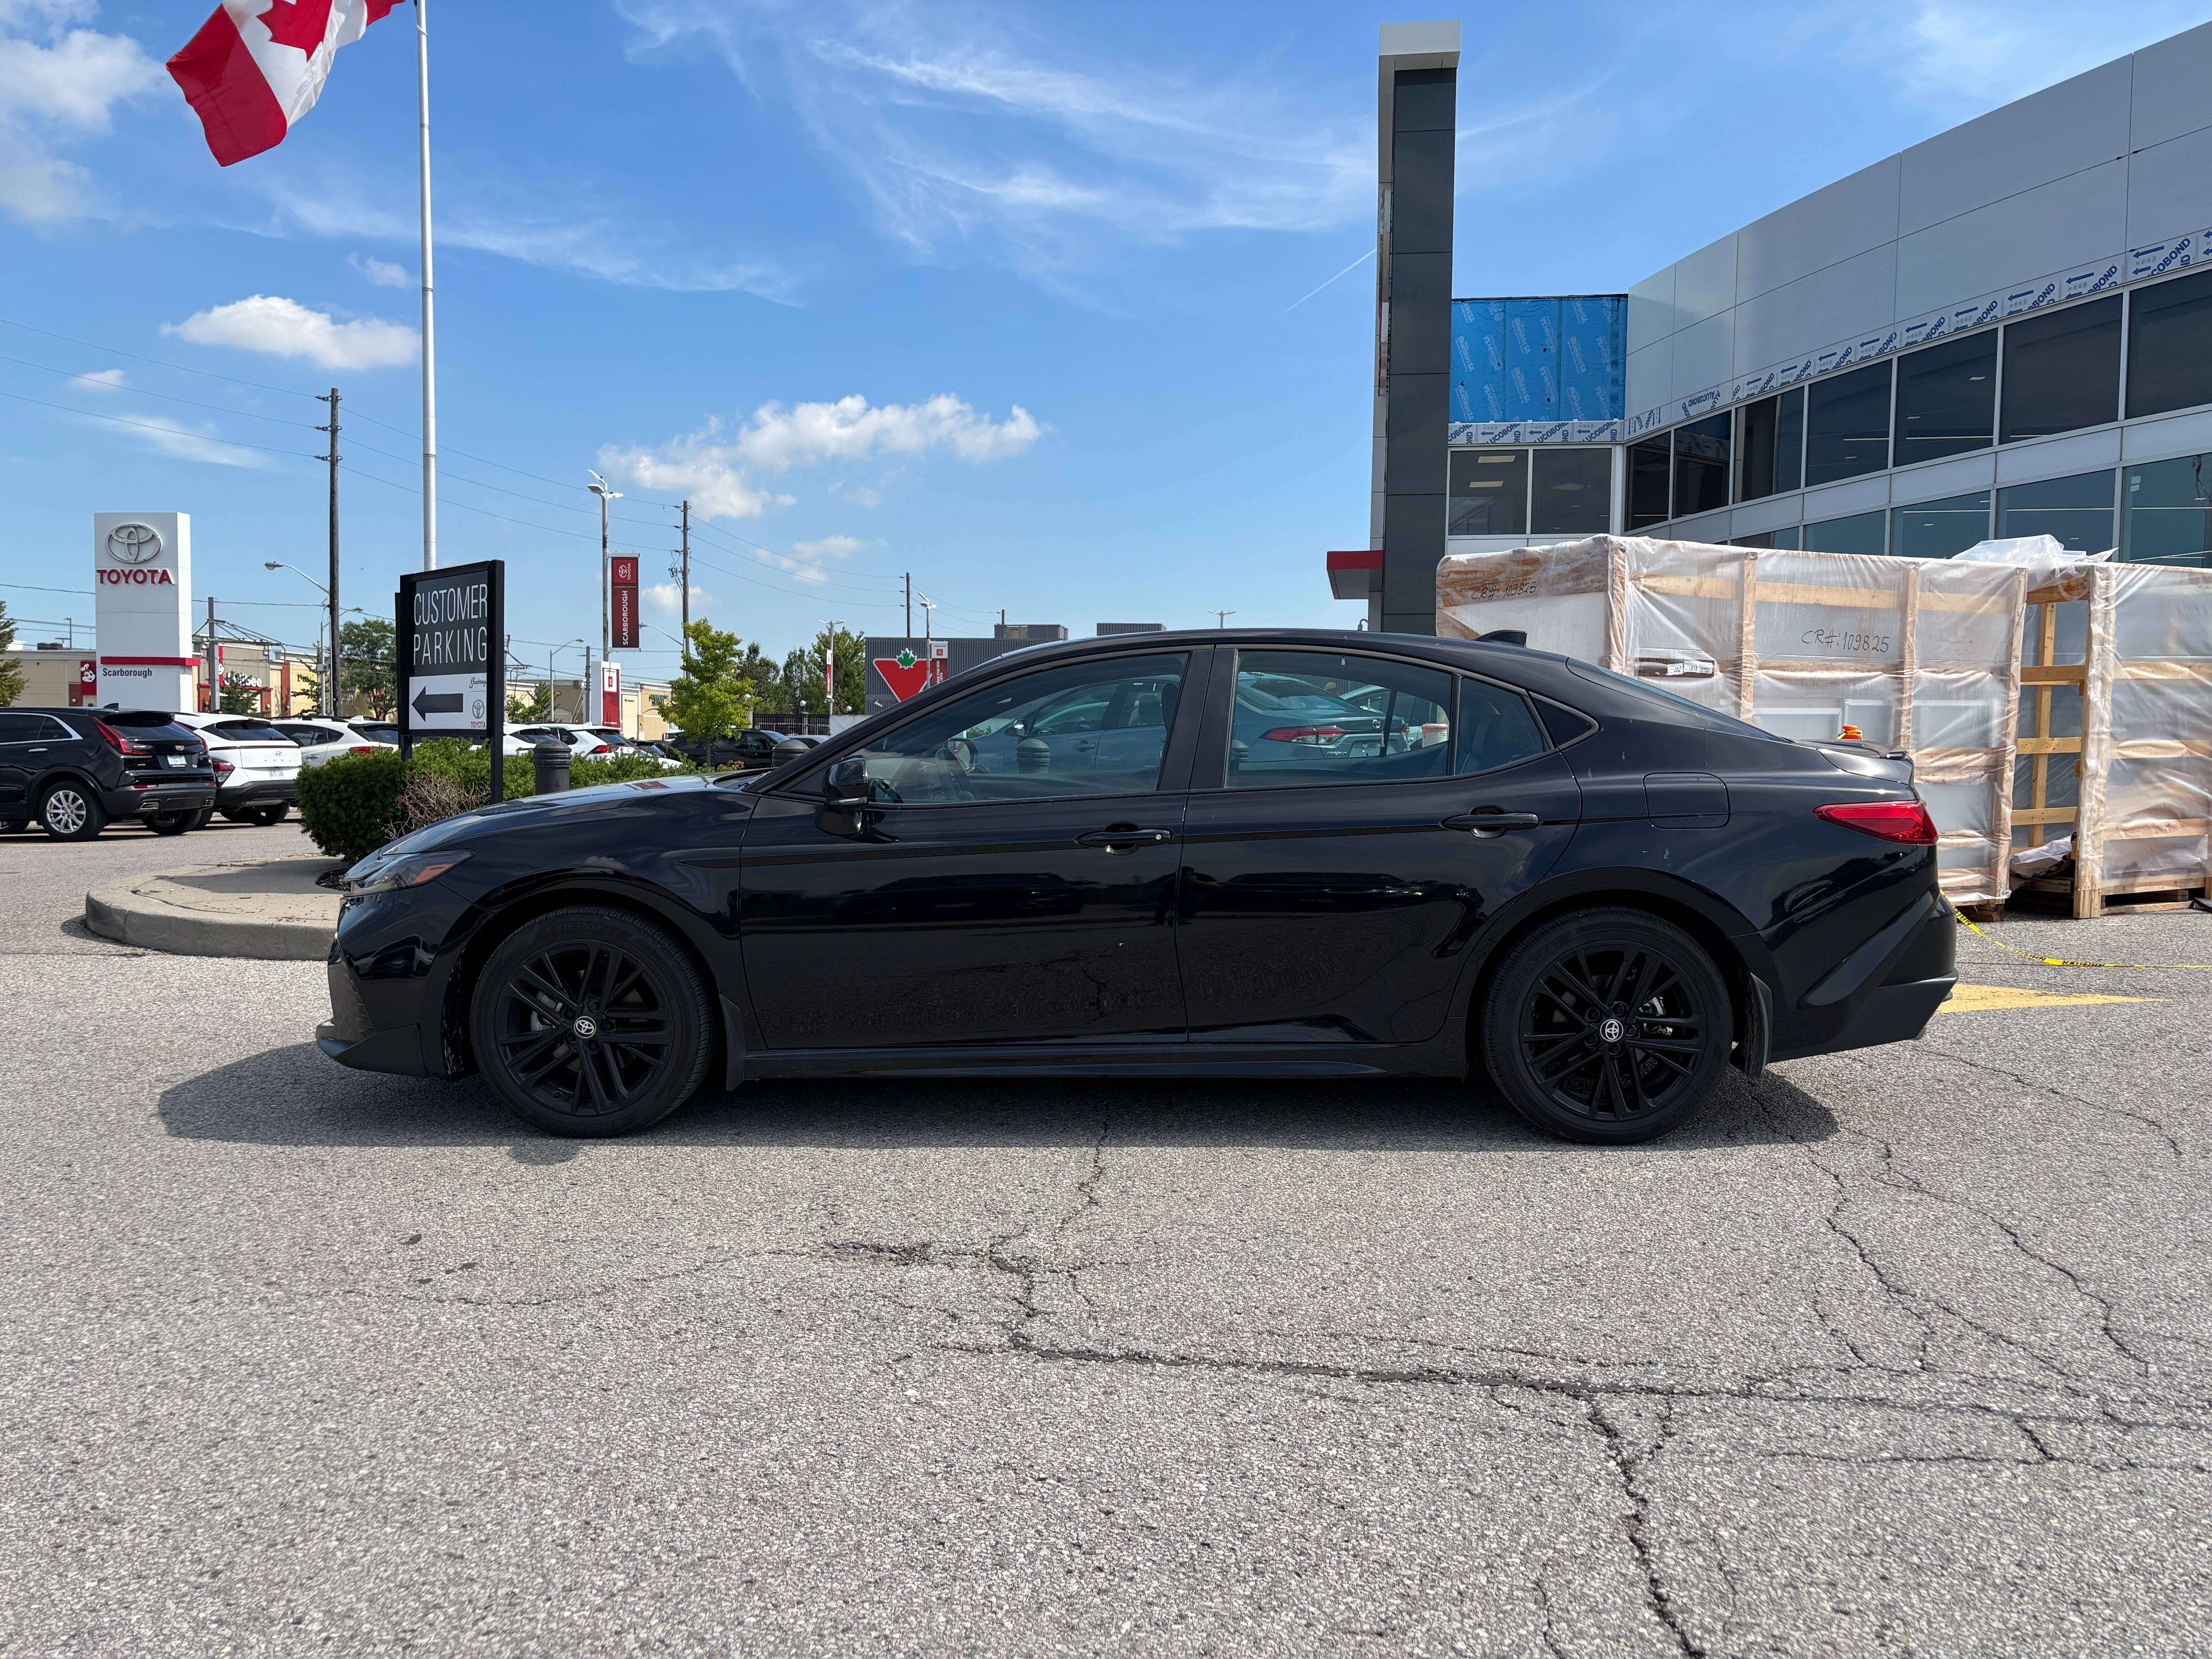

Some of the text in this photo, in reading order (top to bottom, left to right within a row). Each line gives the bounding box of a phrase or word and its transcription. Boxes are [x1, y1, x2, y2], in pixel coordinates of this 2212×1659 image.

[96, 569, 175, 584] TOYOTA
[1503, 582, 1536, 598] 109825
[414, 584, 488, 626] CUSTOMER
[414, 626, 487, 665] PARKING
[1843, 631, 1889, 652] 109825
[103, 668, 152, 678] Scarborough
